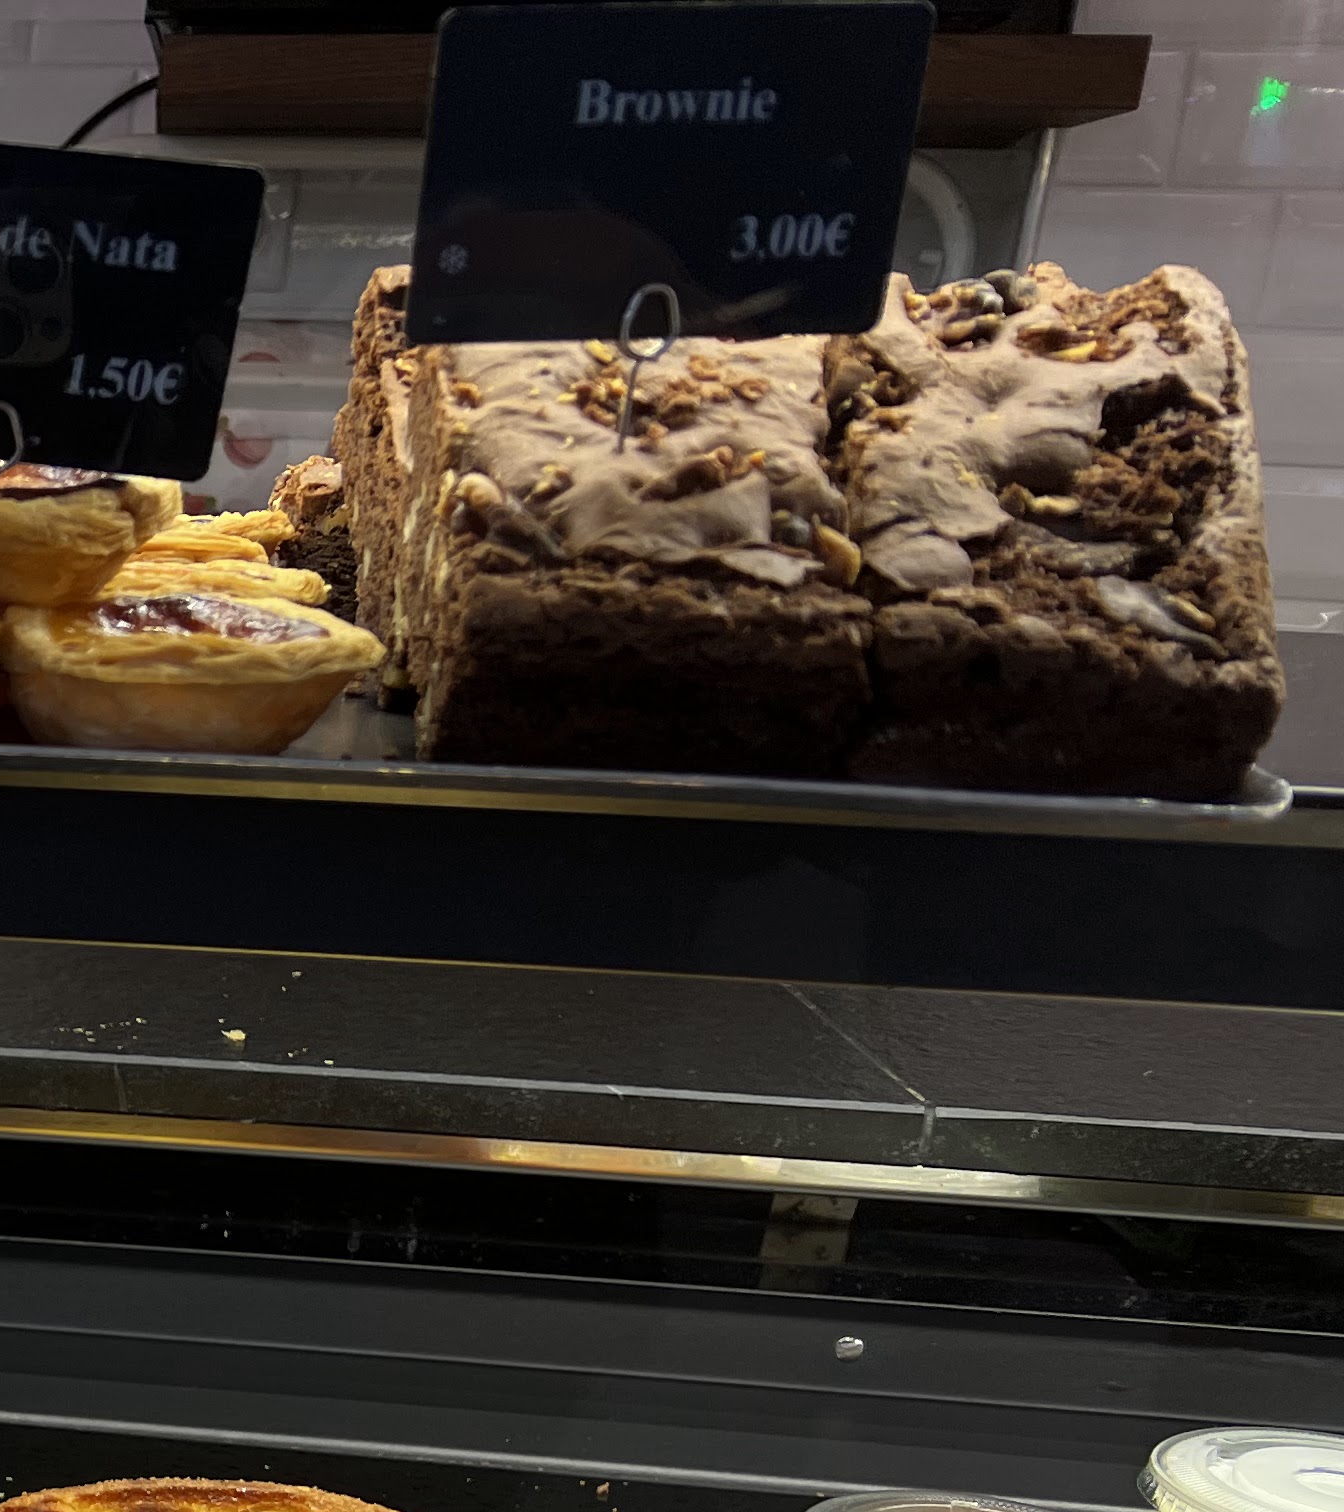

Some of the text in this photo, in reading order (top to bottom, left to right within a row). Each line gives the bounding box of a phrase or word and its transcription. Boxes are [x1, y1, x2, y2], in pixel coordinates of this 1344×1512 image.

[575, 76, 779, 127] Brownie
[70, 219, 180, 273] Nata
[63, 353, 184, 406] 1,50€
